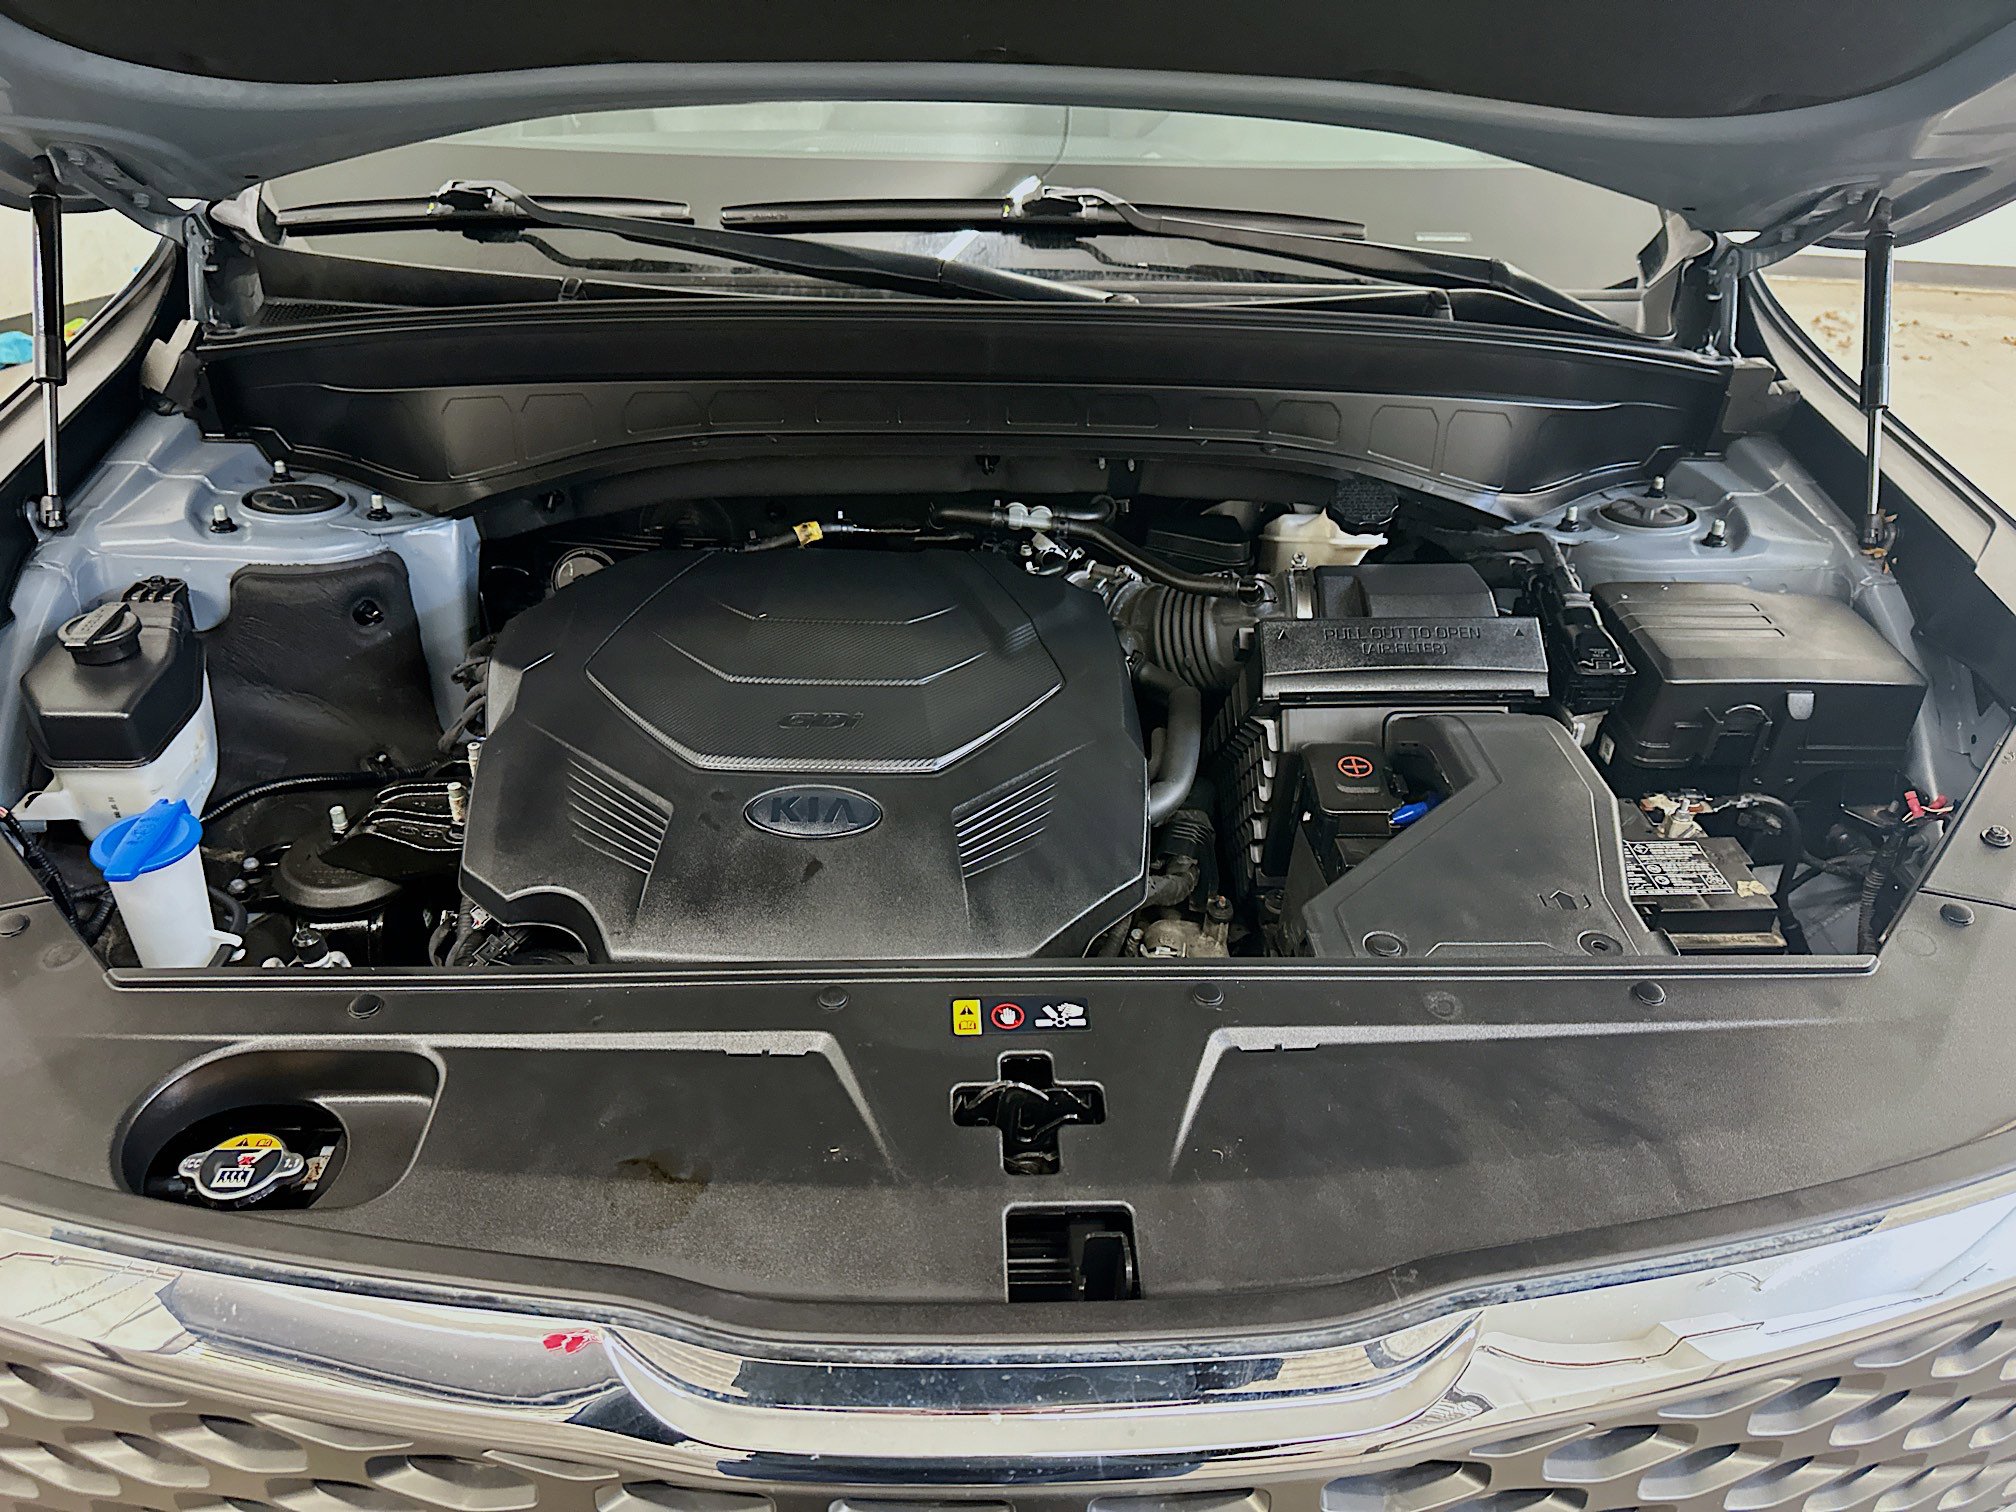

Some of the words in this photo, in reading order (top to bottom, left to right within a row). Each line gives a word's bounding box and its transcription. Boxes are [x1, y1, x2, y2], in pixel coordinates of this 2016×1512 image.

[1323, 627, 1366, 641] PULL
[1370, 626, 1404, 640] OUT
[1408, 626, 1432, 639] TO
[1434, 626, 1481, 639] OPEN
[770, 796, 858, 826] KIA
